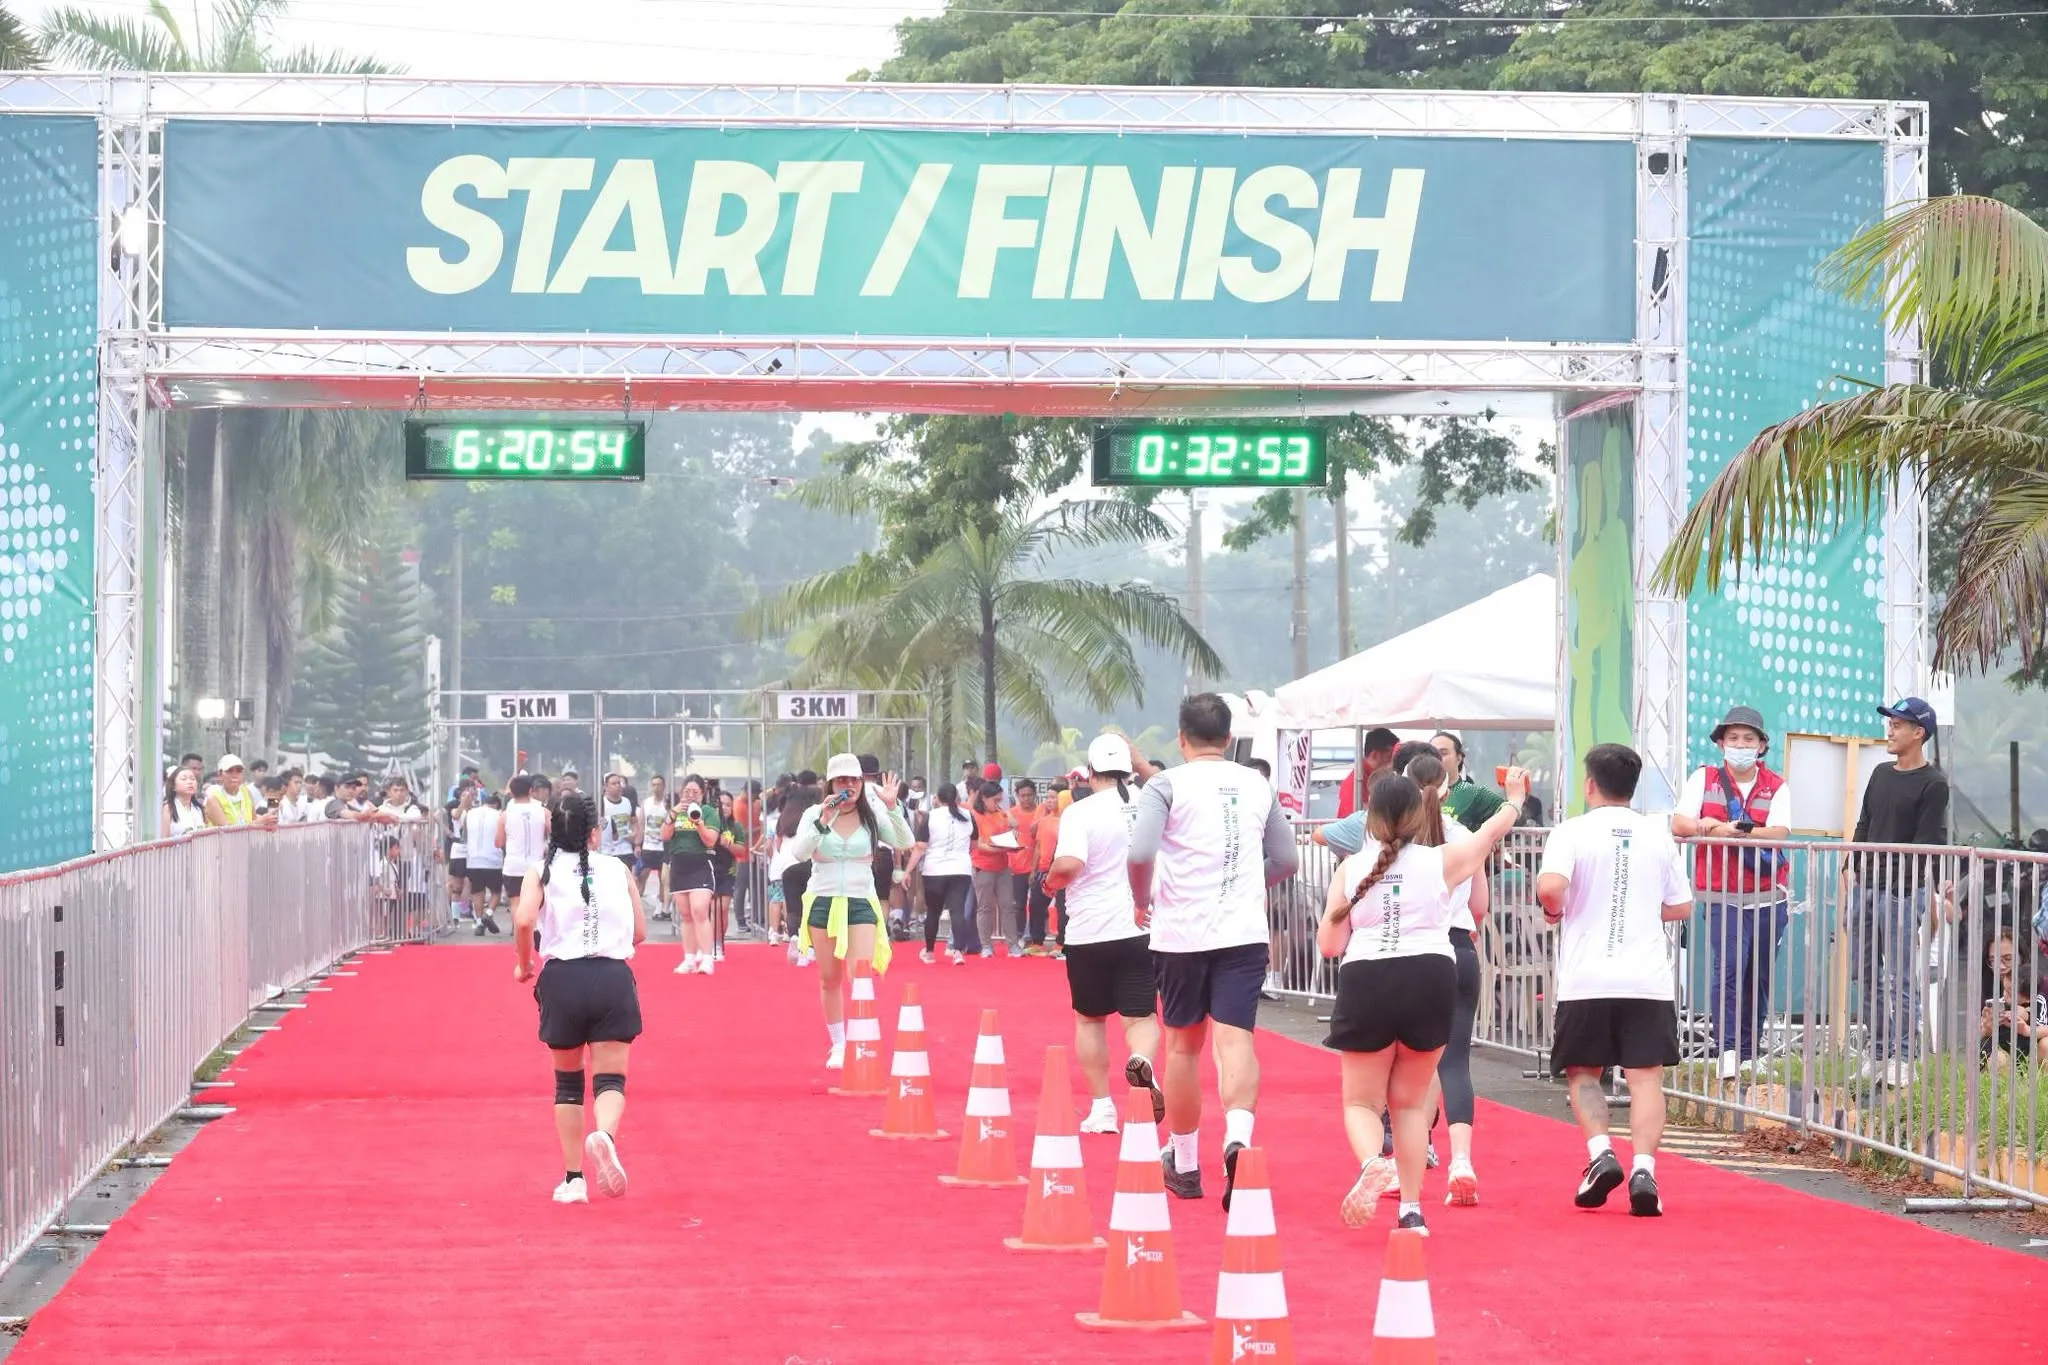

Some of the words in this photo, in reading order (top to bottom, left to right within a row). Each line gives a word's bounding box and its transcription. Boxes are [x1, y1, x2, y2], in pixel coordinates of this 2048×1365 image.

[406, 154, 865, 295] START
[859, 163, 953, 296] /
[957, 165, 1426, 303] FINISH
[452, 429, 626, 471] 6:20:54
[1137, 435, 1310, 476] 0:32:53
[500, 697, 557, 718] 5KM
[791, 697, 846, 717] 3KM
